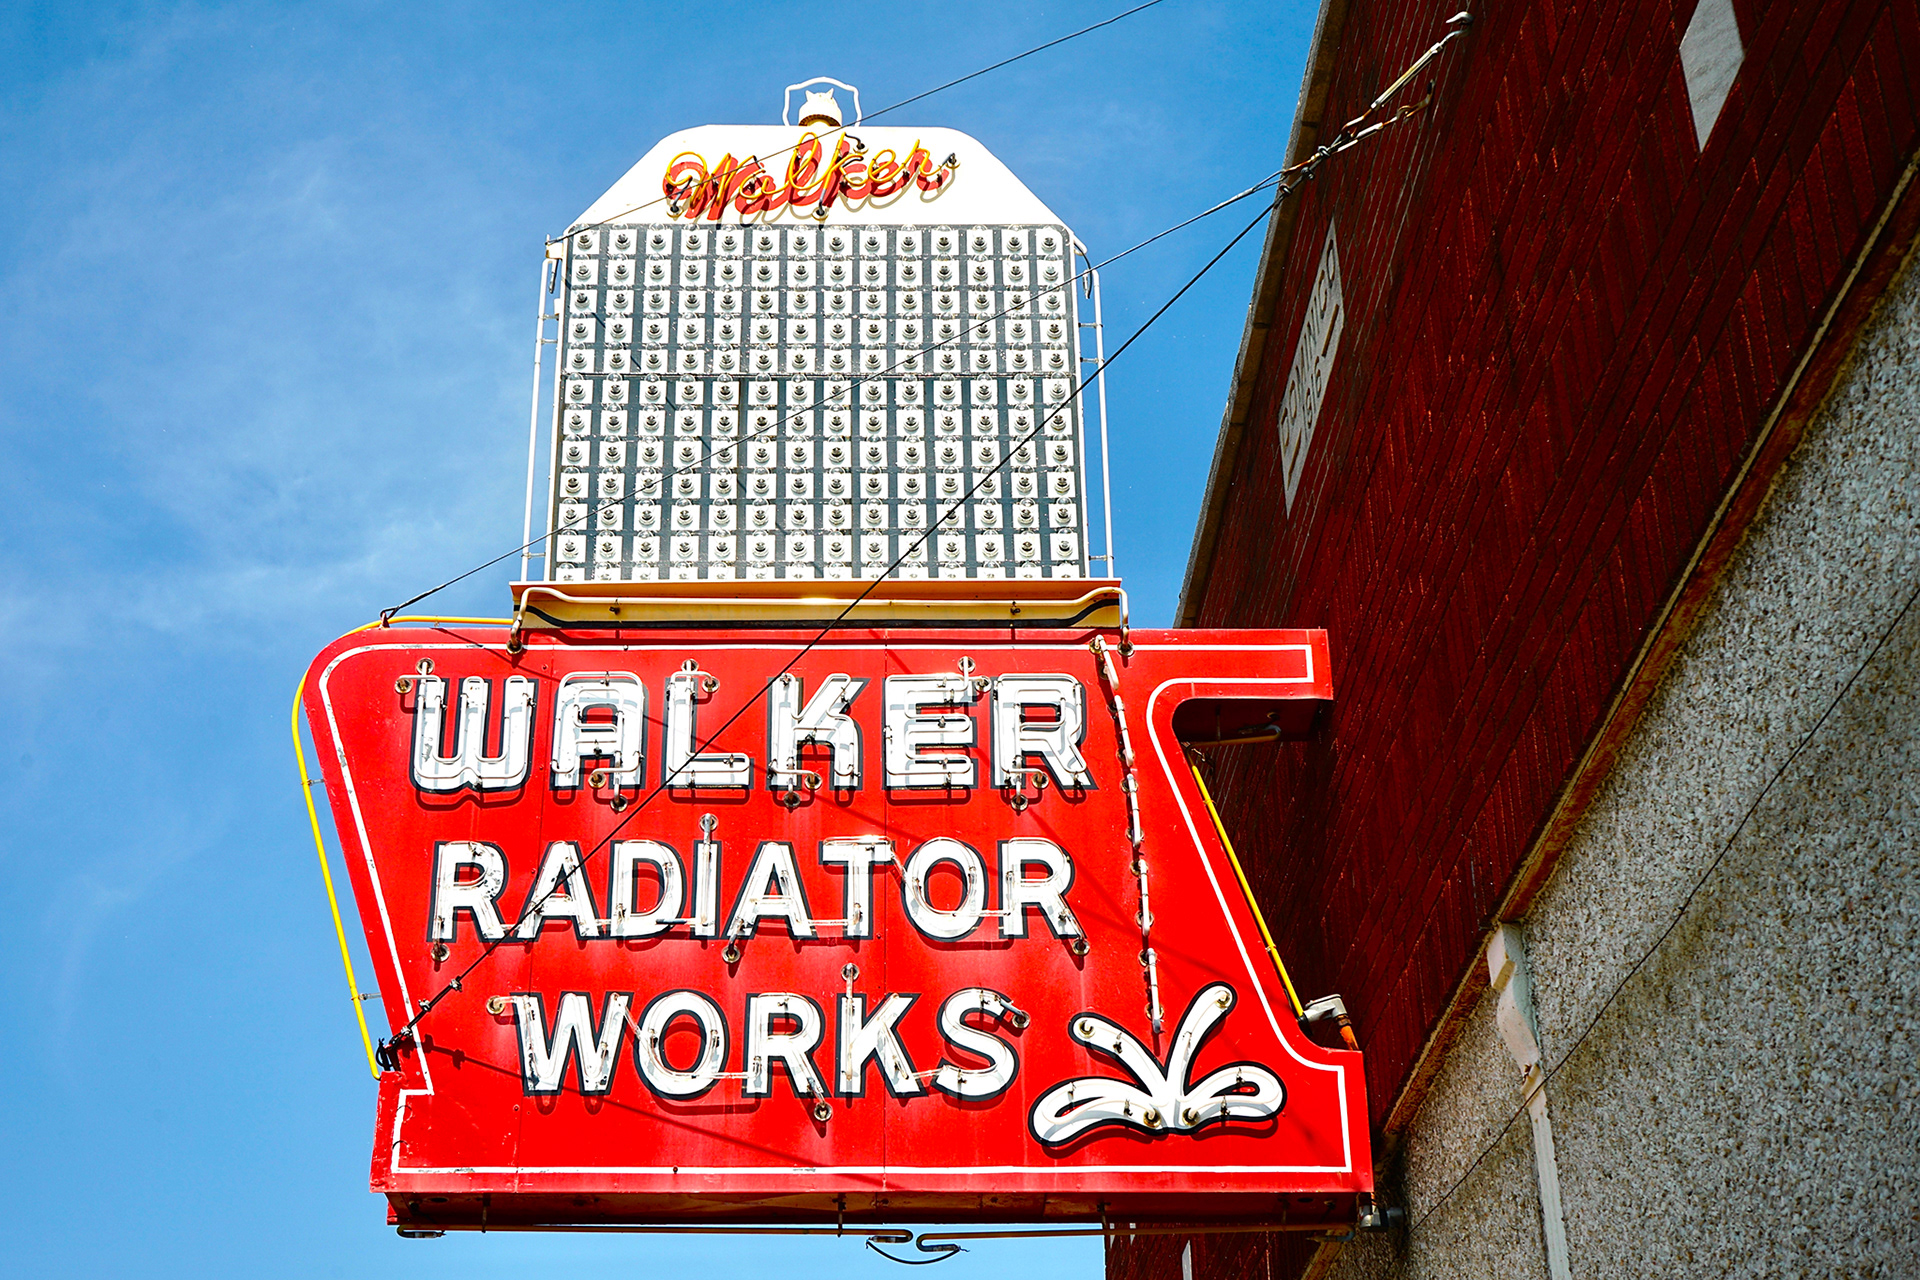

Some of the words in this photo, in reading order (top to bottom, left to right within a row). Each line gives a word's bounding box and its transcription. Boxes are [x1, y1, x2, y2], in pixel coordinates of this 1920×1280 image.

[662, 131, 955, 220] Walker
[408, 671, 1099, 793] WALKER
[427, 836, 1087, 943] RADIATOR
[509, 987, 1020, 1101] WORKS
